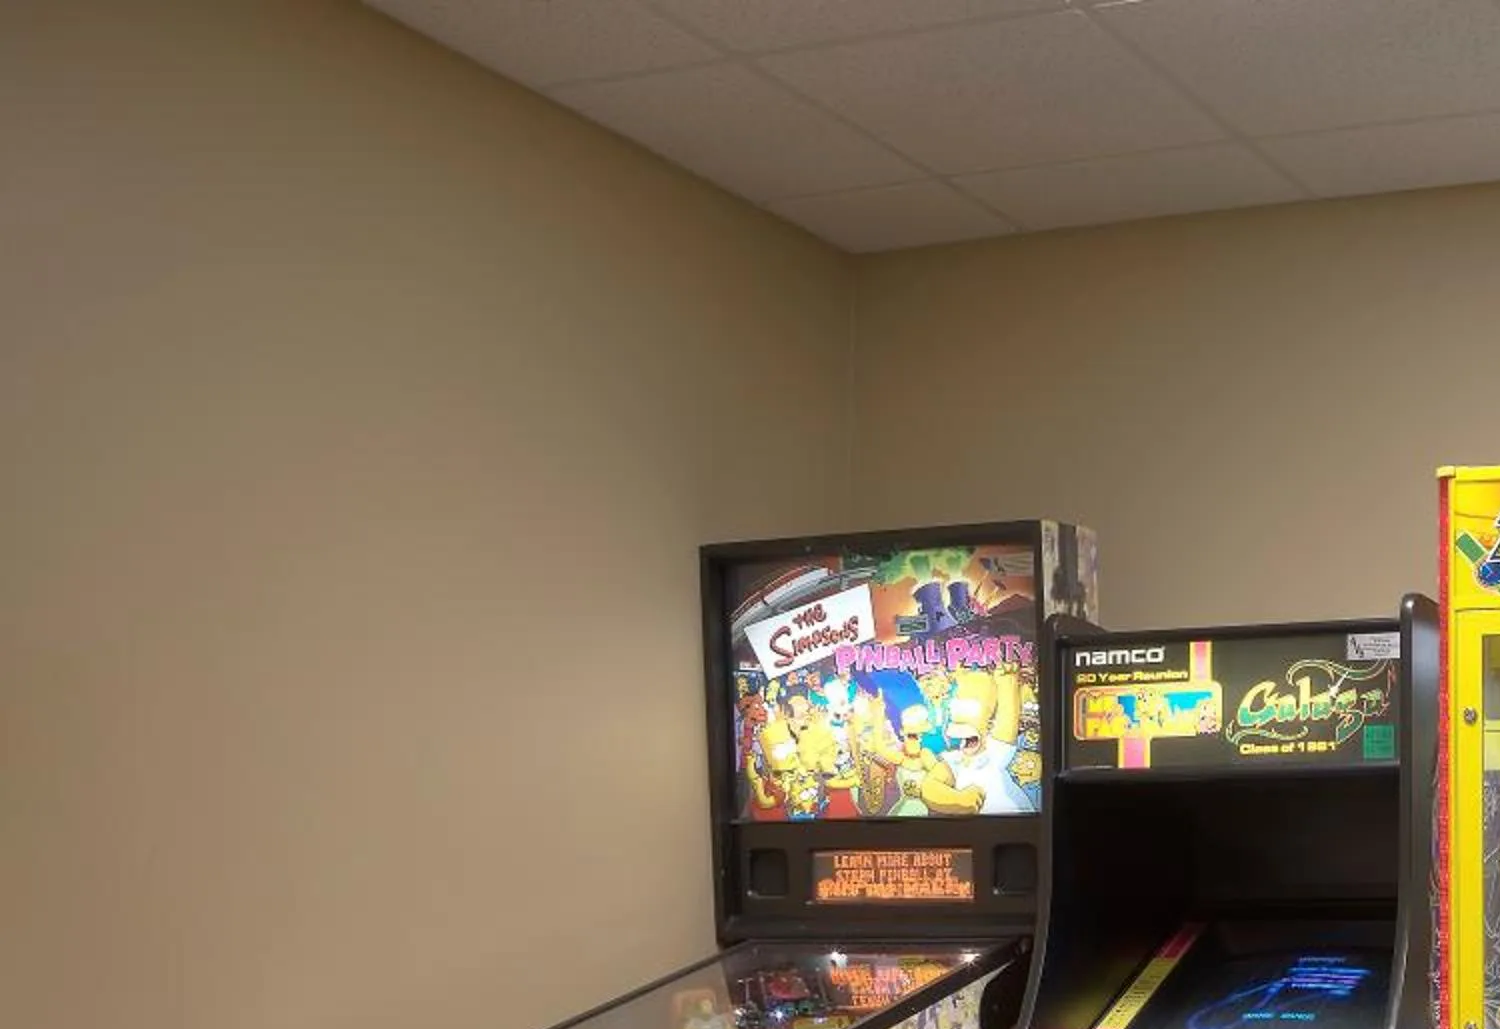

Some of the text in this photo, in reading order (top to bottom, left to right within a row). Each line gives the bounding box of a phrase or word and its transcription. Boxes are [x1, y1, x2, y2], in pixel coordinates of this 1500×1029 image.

[834, 635, 1035, 675] PINBALL PARTY
[1075, 646, 1165, 666] namco
[1098, 672, 1131, 682] Year
[1133, 670, 1188, 681] Reunion
[1240, 741, 1336, 755] Class of 1981
[877, 853, 910, 867] MORE
[913, 852, 952, 867] ABOUT
